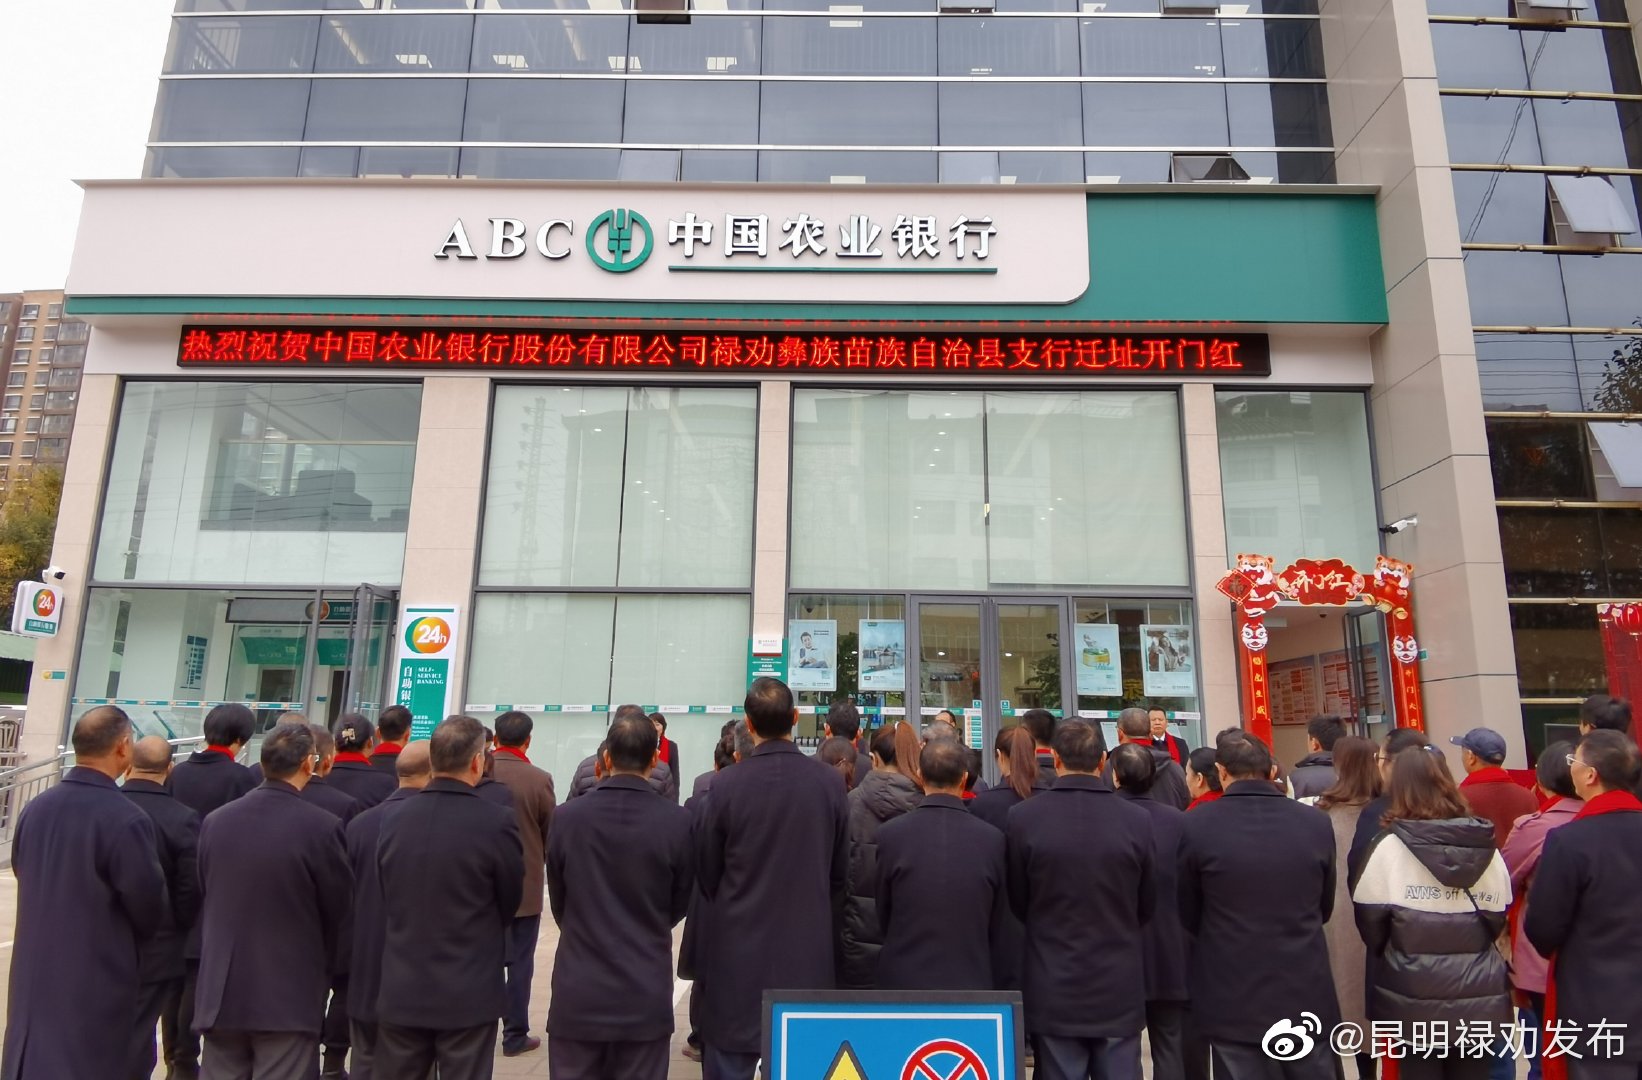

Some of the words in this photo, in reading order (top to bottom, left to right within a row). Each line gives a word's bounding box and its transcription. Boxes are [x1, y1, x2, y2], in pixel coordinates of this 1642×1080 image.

[434, 217, 574, 260] ABC
[667, 211, 998, 259] 中国农业银行
[182, 330, 1244, 369] 热烈祝贺中国农业银行股份有限公司禄劝彝族苗族自治县支行迁址开门红
[1290, 569, 1350, 593] 开门红
[416, 624, 447, 644] 24h
